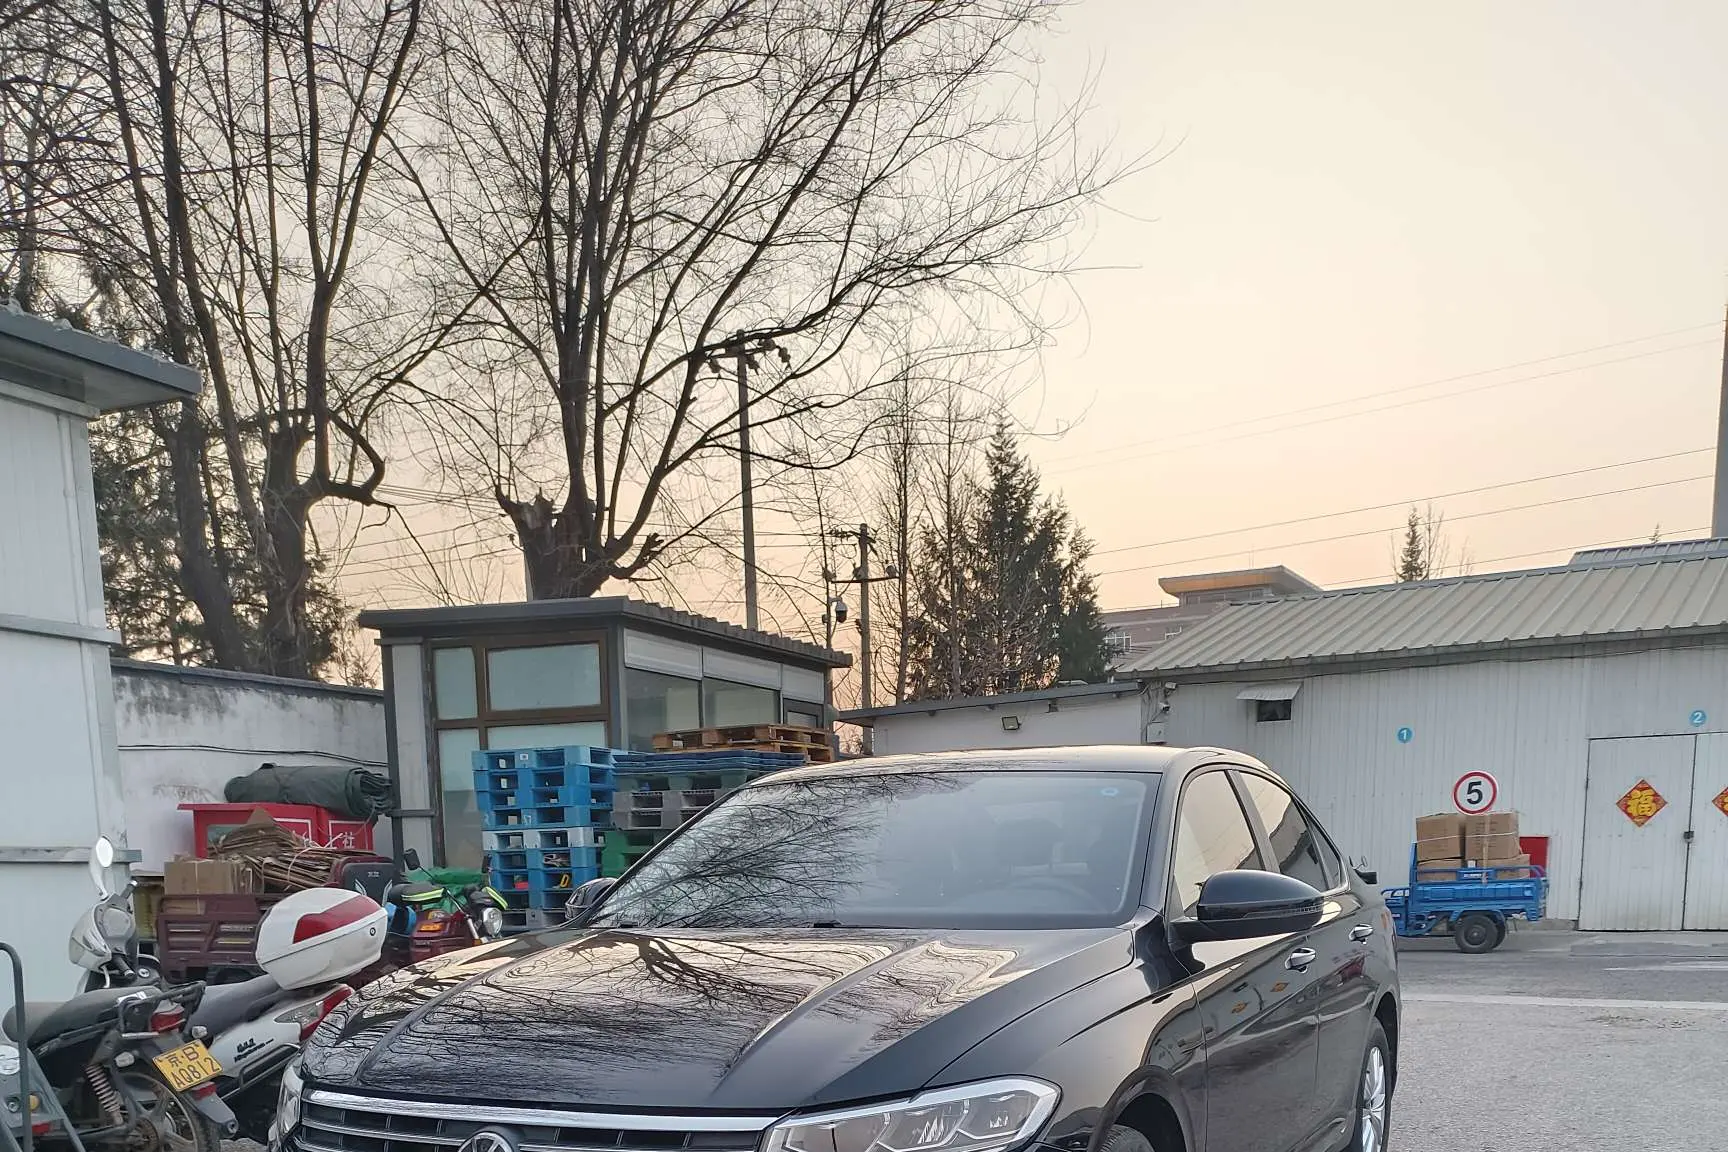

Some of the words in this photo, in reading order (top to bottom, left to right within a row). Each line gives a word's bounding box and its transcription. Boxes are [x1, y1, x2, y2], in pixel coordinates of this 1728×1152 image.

[1693, 711, 1703, 723] 2
[1466, 780, 1483, 805] 5
[1626, 787, 1657, 817] 福
